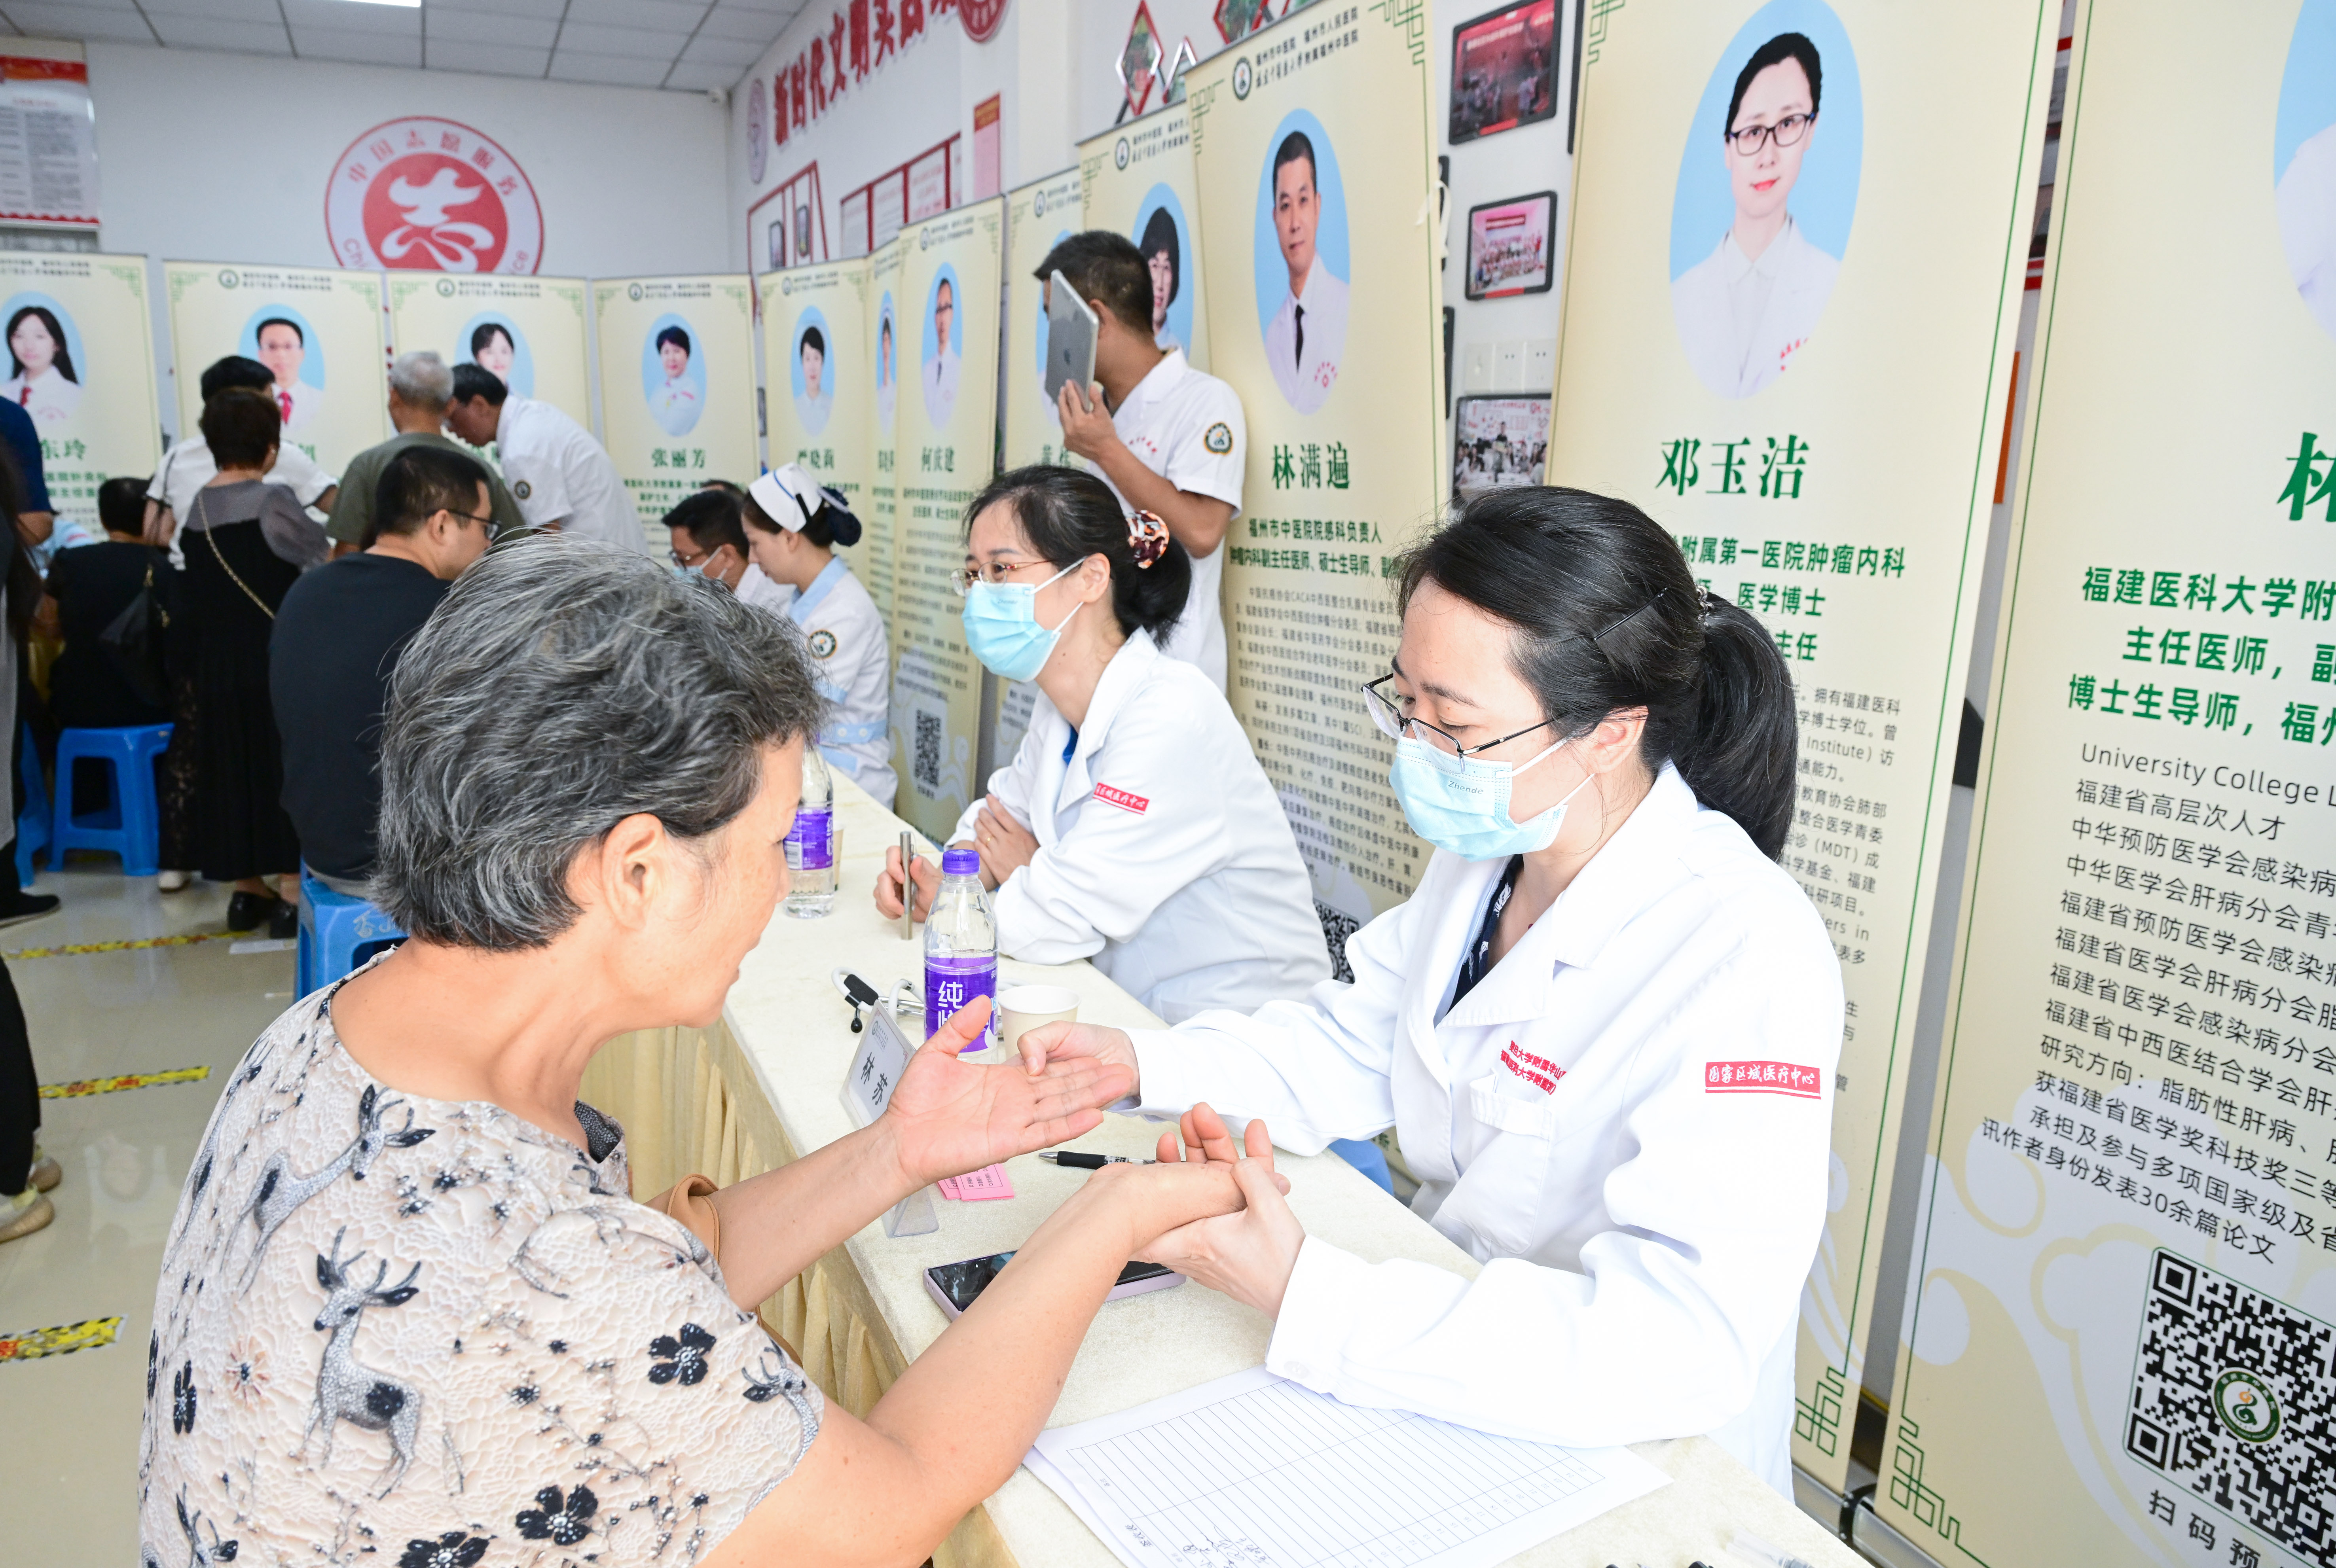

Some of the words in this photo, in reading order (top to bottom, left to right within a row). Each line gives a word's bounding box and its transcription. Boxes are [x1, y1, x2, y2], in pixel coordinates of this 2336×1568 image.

[1271, 440, 1350, 490] 林满遍
[1655, 434, 1810, 500] 邓玉洁
[2277, 431, 2336, 523] 林
[1249, 518, 1383, 544] 福州市中医院院感科负责人
[1674, 535, 1906, 578] 附属第一医院肿瘤内科
[1229, 545, 1403, 578] 肿瘤内科副主任医师、硕士生导师、副
[1737, 582, 1826, 617] 医学博士
[2082, 565, 2336, 622] 福建医科大学附
[1775, 629, 1818, 661] 主任
[1448, 780, 1484, 794] Zhende
[2082, 743, 2207, 786] University
[2214, 765, 2319, 804] College
[1792, 809, 1883, 845] 整合医学青委
[2076, 778, 2286, 841] 福建省高层次人才
[2072, 816, 2336, 898] 中华预防医学会感染病
[1797, 880, 1865, 917] 科研项目。
[2067, 853, 2336, 940] 中华医学会肝病分会青
[1855, 925, 1870, 941] in
[2050, 961, 2336, 1075] 福建省医学会感染病分会
[1708, 1064, 1815, 1088] 国家区域医疗中心
[2044, 997, 2336, 1116] 福建省中西医结合学会肝
[2035, 1070, 2336, 1209] 获福建省医学奖科技奖三等
[1981, 1116, 2277, 1265] 讯作者身份发表30余篇论文
[2029, 1105, 2336, 1251] 承担及参与多项国家级及省
[2148, 1489, 2285, 1568] 扫码预
